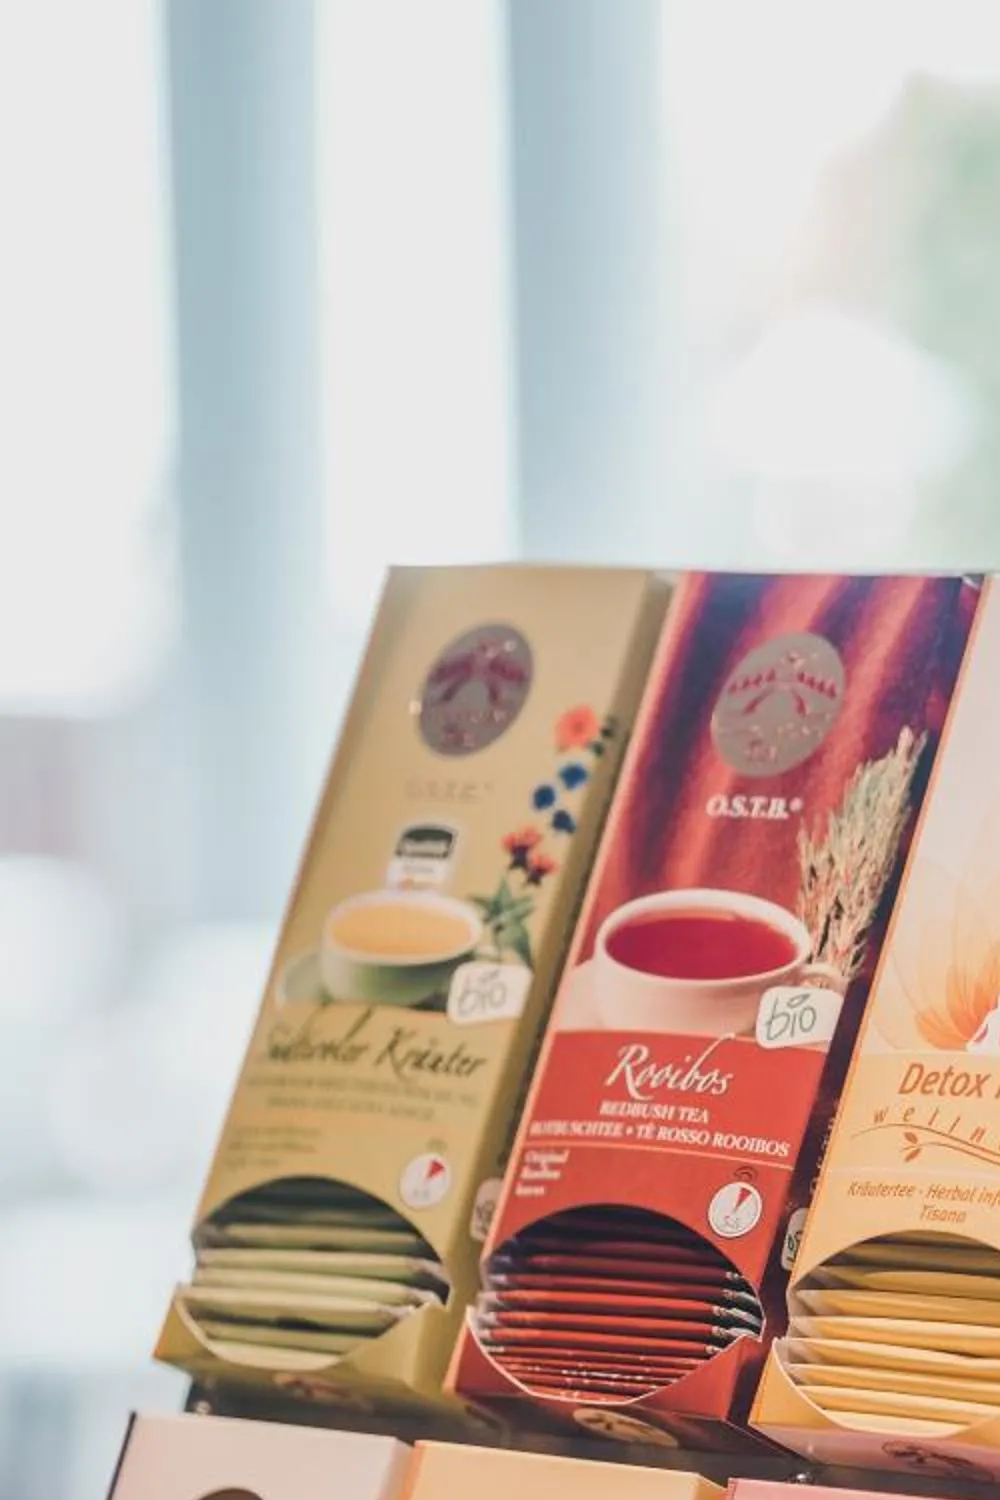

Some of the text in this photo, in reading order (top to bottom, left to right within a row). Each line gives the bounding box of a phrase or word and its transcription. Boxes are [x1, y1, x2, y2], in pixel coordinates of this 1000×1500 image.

[766, 993, 817, 1041] bio
[605, 1032, 735, 1101] Rooibos
[898, 1061, 992, 1098] Detox
[677, 1106, 710, 1124] TEA
[657, 1126, 711, 1146] ROSSO
[712, 1135, 791, 1158] ROOIBOS
[847, 1180, 916, 1198] Kräutertee
